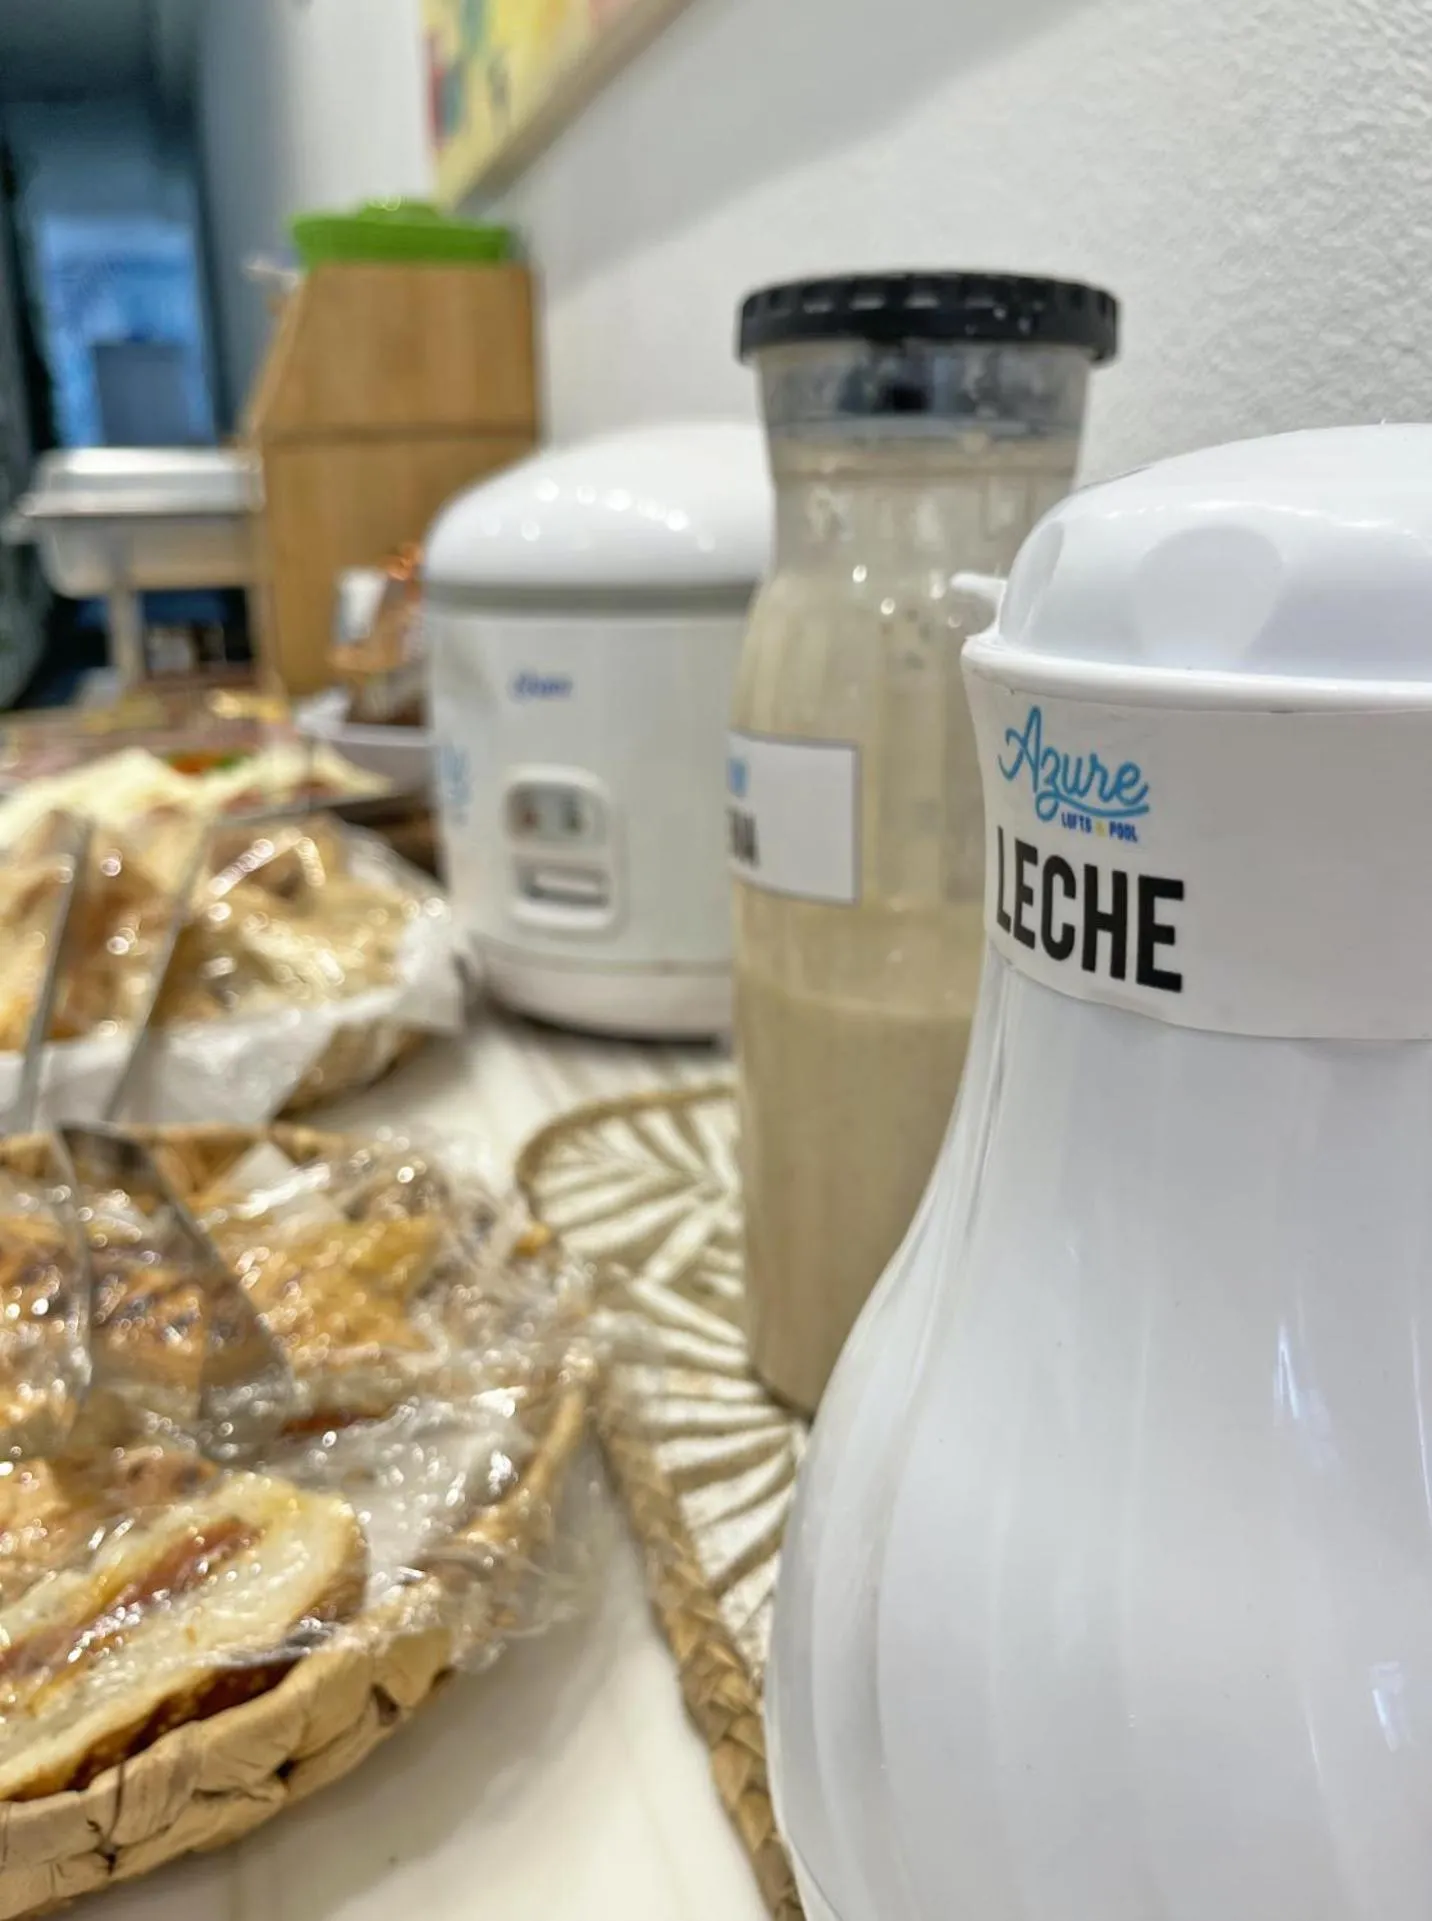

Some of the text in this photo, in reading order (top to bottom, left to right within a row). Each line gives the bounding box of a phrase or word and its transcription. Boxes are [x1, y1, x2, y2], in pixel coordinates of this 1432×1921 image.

[998, 705, 1150, 822] Azure
[1109, 821, 1138, 843] POOL
[997, 826, 1185, 993] LECHE
